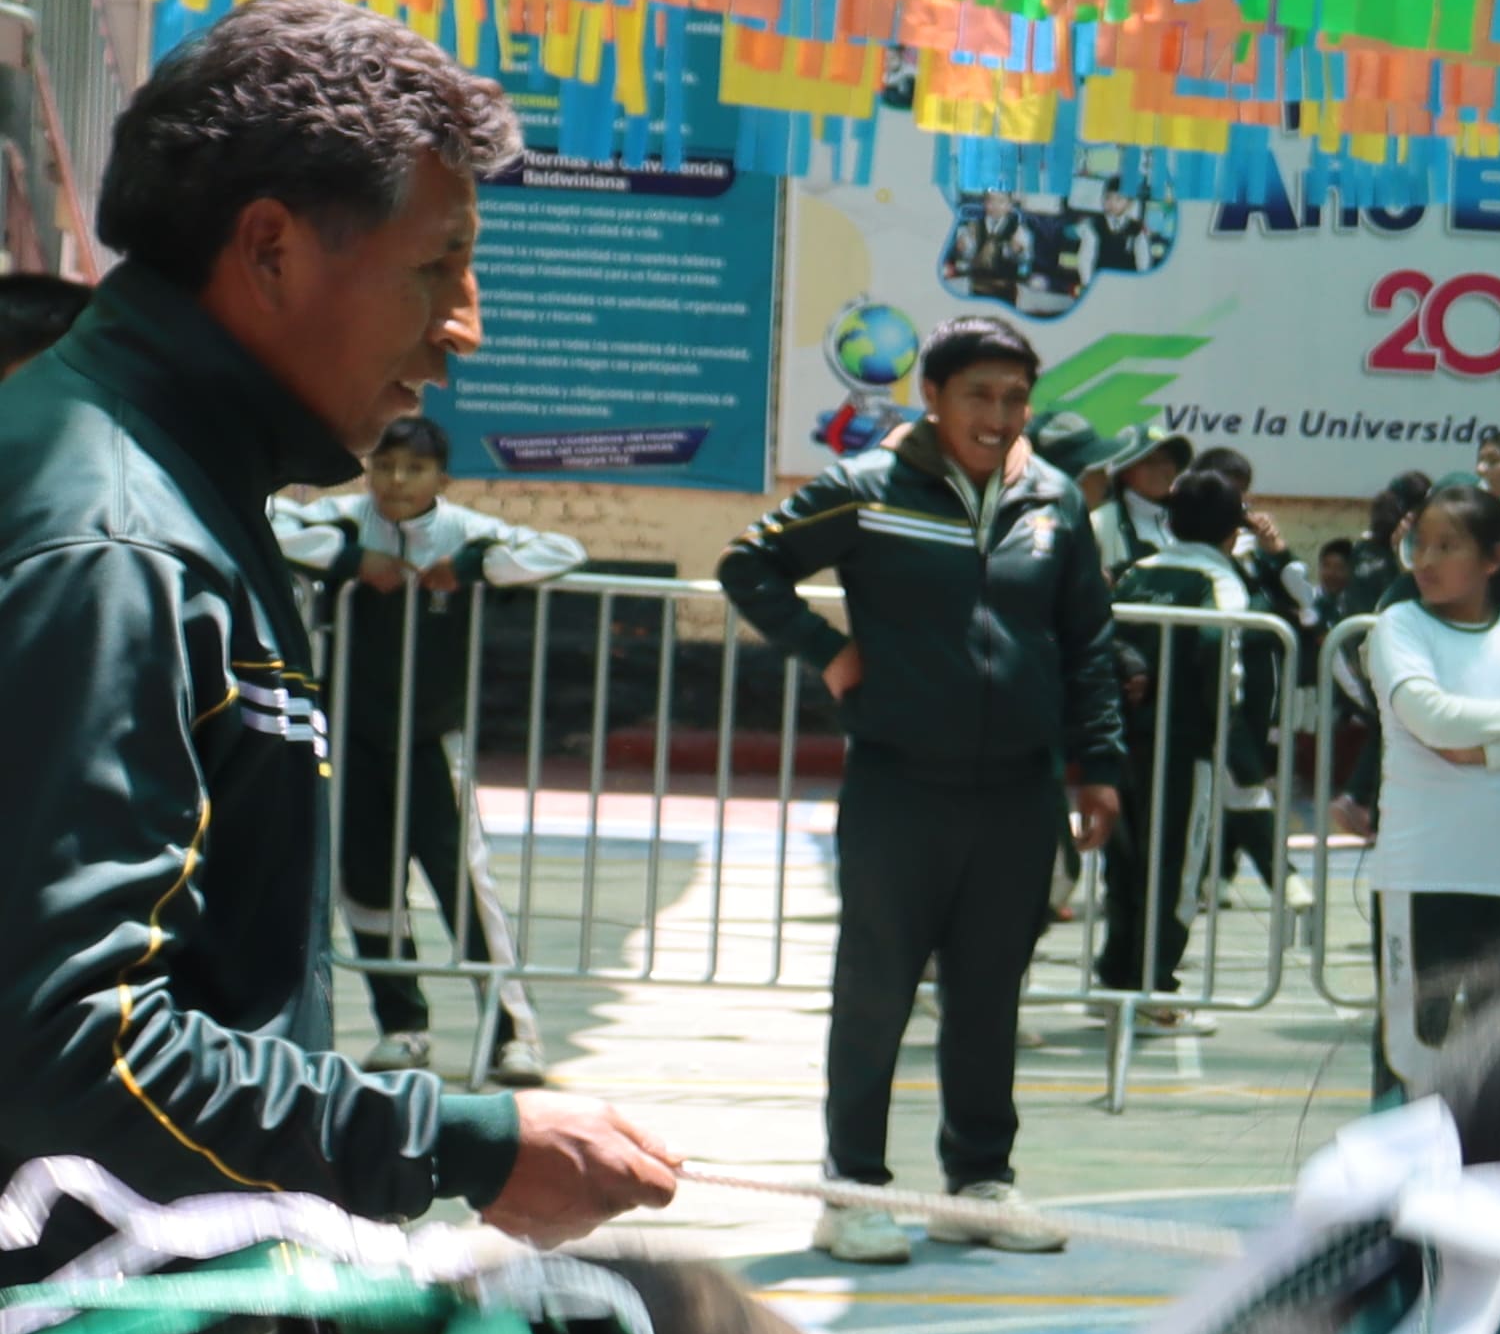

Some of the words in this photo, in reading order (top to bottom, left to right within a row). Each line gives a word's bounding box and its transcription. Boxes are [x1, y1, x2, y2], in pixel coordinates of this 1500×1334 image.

[523, 170, 627, 191] Baldwiniana
[1164, 404, 1242, 435] Vive
[1252, 407, 1288, 437] la
